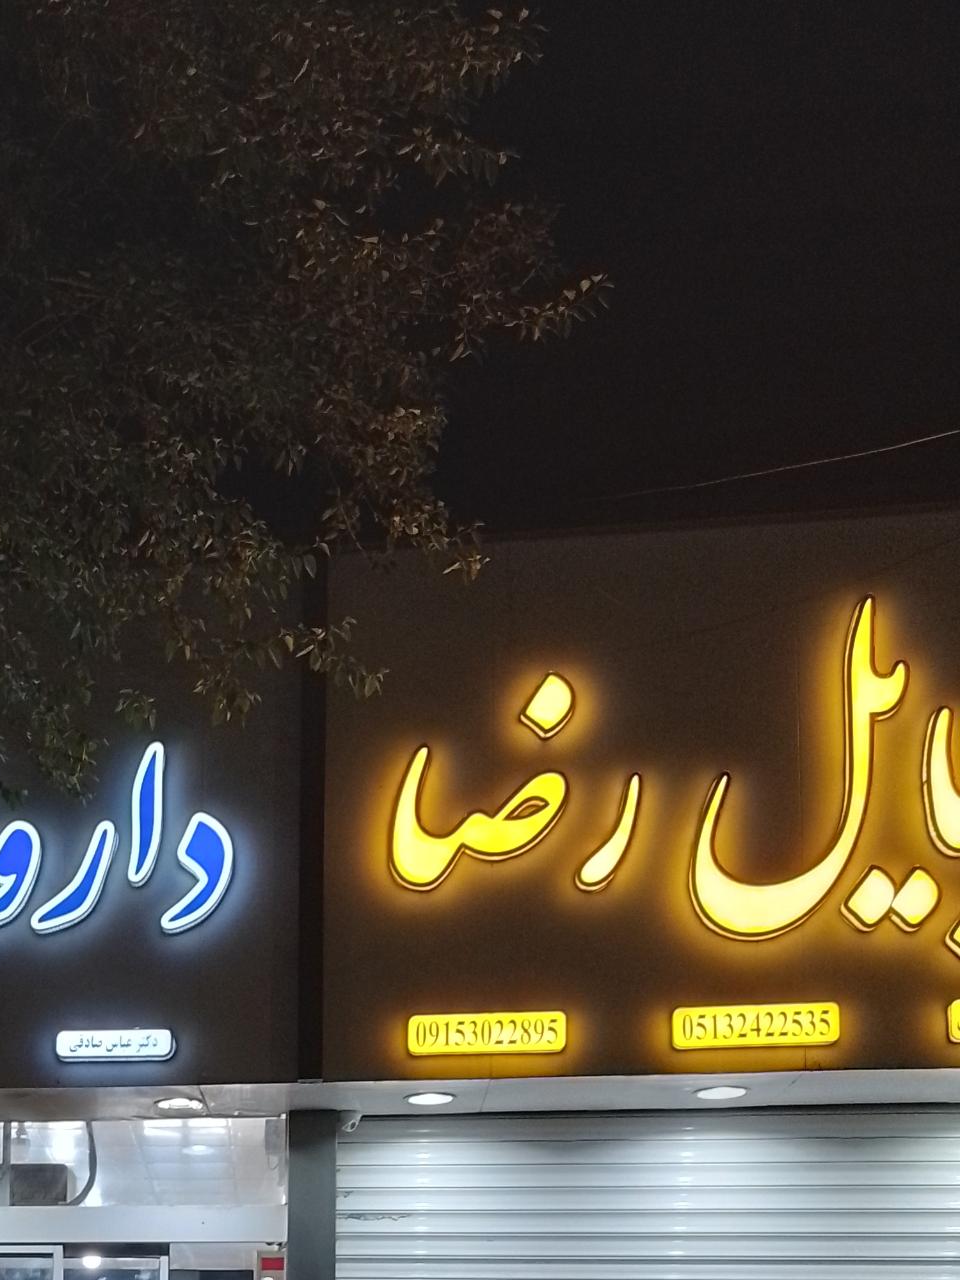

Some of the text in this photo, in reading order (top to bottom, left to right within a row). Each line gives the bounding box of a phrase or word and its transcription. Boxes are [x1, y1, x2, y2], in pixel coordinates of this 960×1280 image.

[388, 670, 642, 893] رضا
[415, 1018, 559, 1048] 09153022895
[682, 1009, 831, 1041] 05132422535
